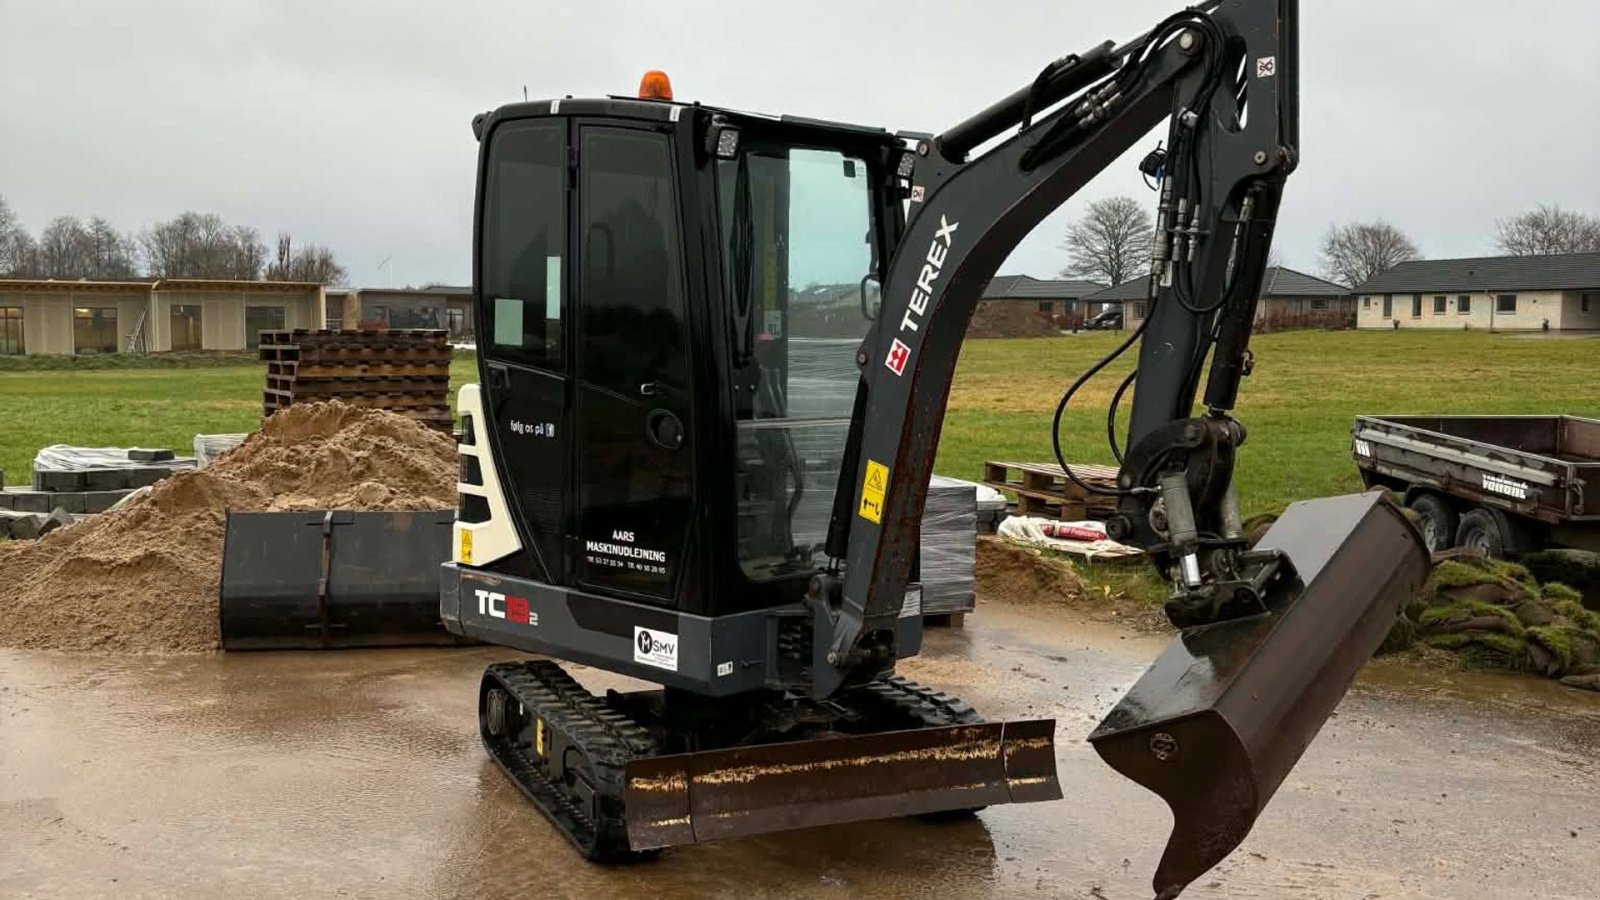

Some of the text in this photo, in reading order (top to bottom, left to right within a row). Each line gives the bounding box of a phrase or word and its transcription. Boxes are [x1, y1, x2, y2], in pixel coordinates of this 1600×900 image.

[900, 214, 959, 332] TEREX
[525, 424, 534, 434] os
[535, 422, 544, 437] på
[612, 529, 635, 542] AARS
[586, 540, 666, 562] MASKINUDLEJNING
[653, 639, 675, 655] SMV
